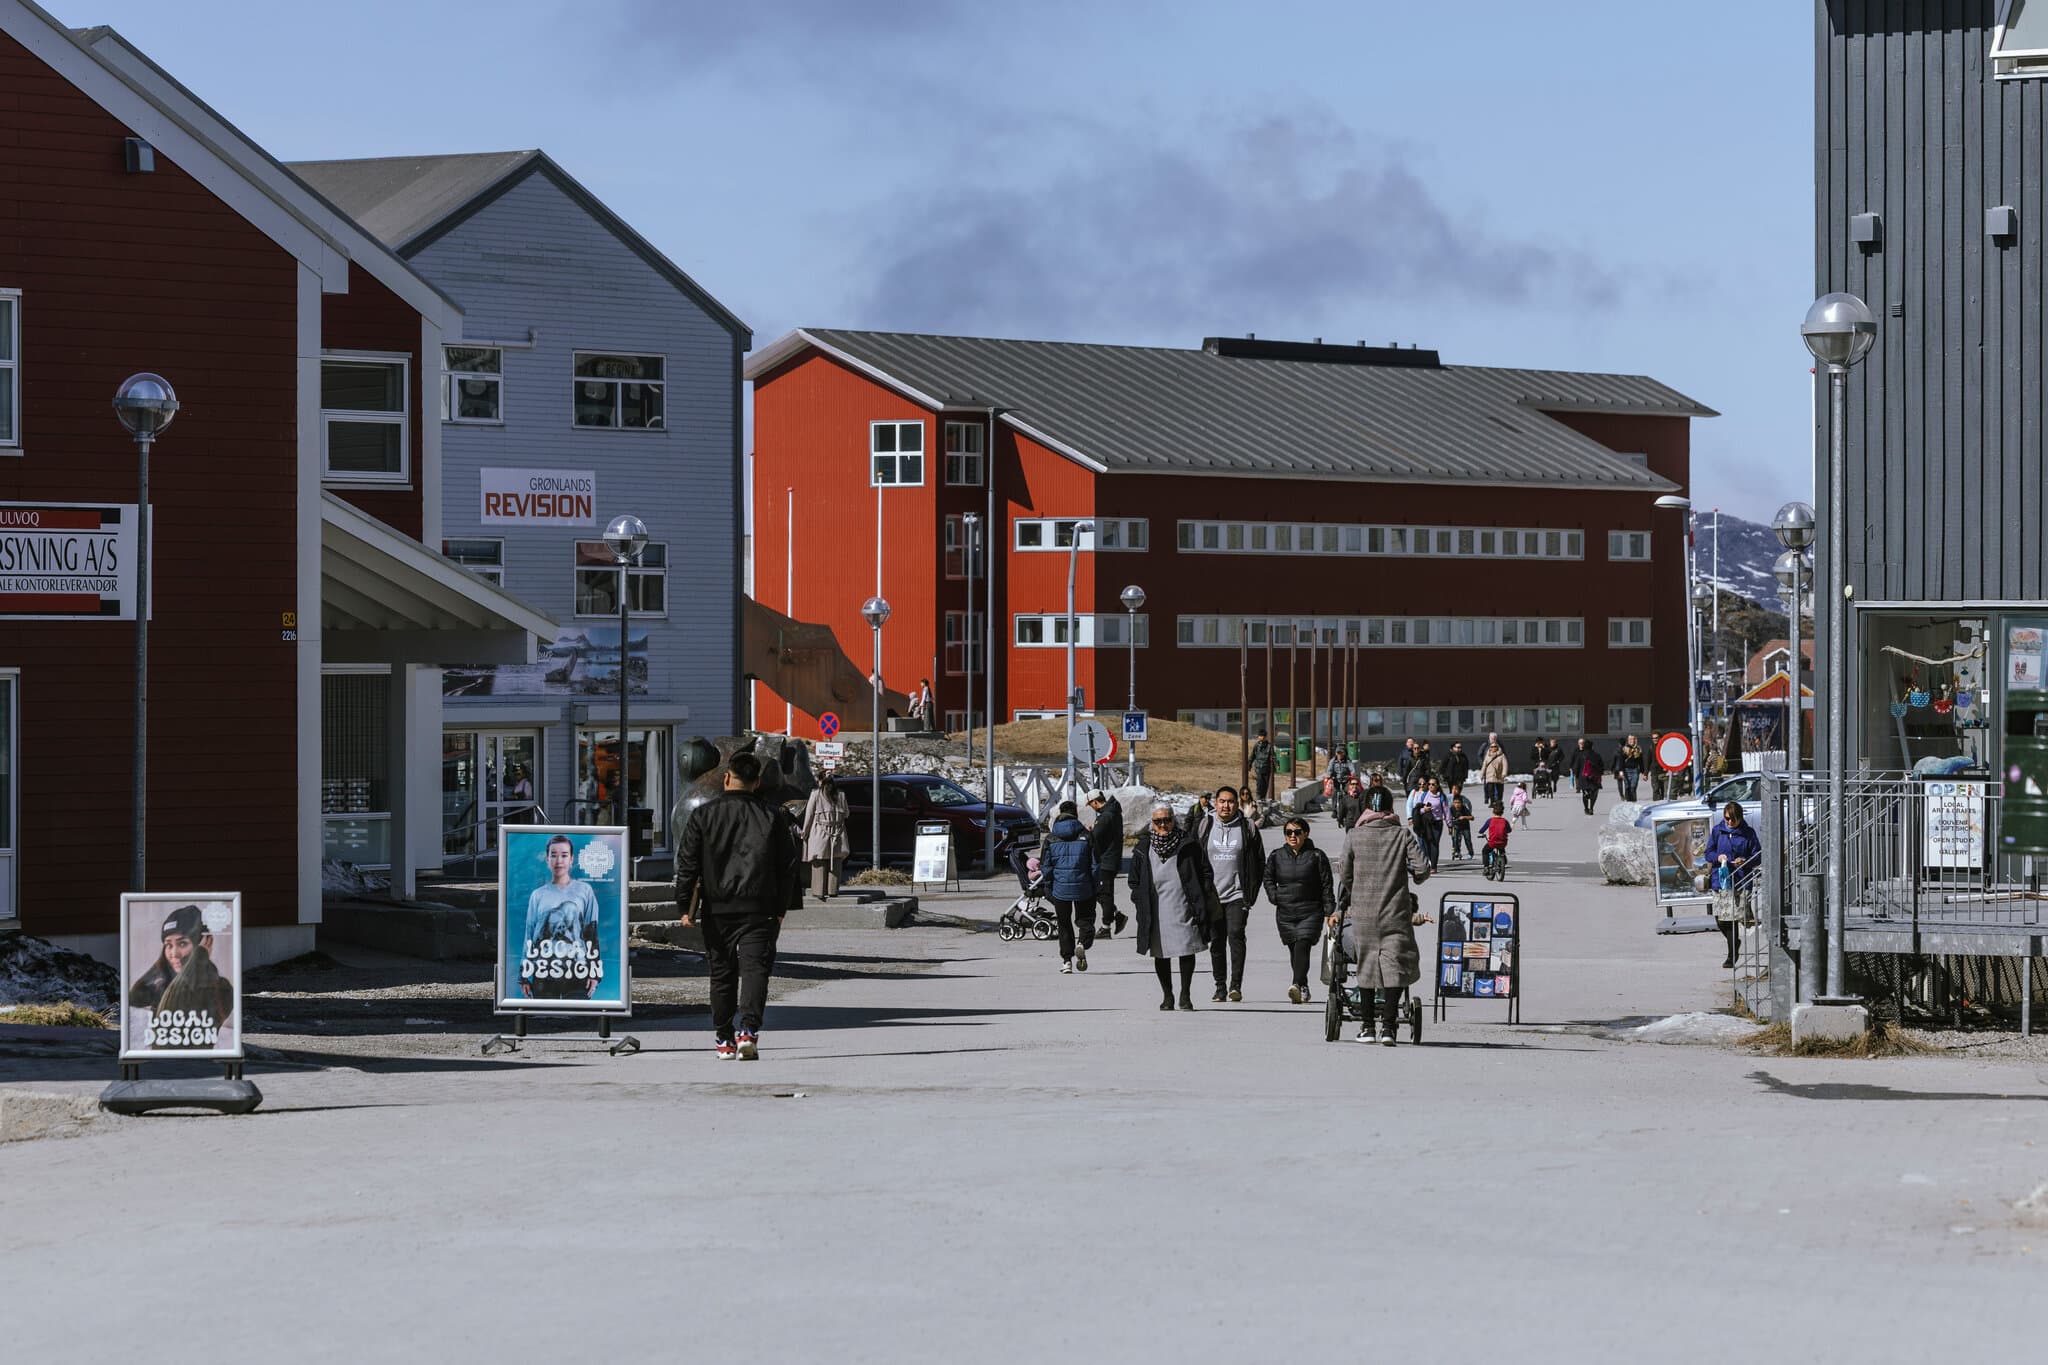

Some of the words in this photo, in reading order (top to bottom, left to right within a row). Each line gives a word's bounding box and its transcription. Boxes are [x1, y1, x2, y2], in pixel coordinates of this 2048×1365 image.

[529, 477, 592, 492] GRØNLANDS
[485, 492, 592, 518] REVISION
[84, 538, 118, 576] A/S
[0, 578, 13, 591] LE
[15, 578, 118, 592] KONTORLEVERANDØR
[284, 614, 295, 625] 24
[282, 630, 297, 641] 2216
[1928, 783, 1981, 797] OPEN
[526, 939, 599, 959] LOCAL
[521, 959, 604, 979] DESIGN
[147, 1010, 214, 1028] LOCAL
[143, 1027, 218, 1046] DESIGN
